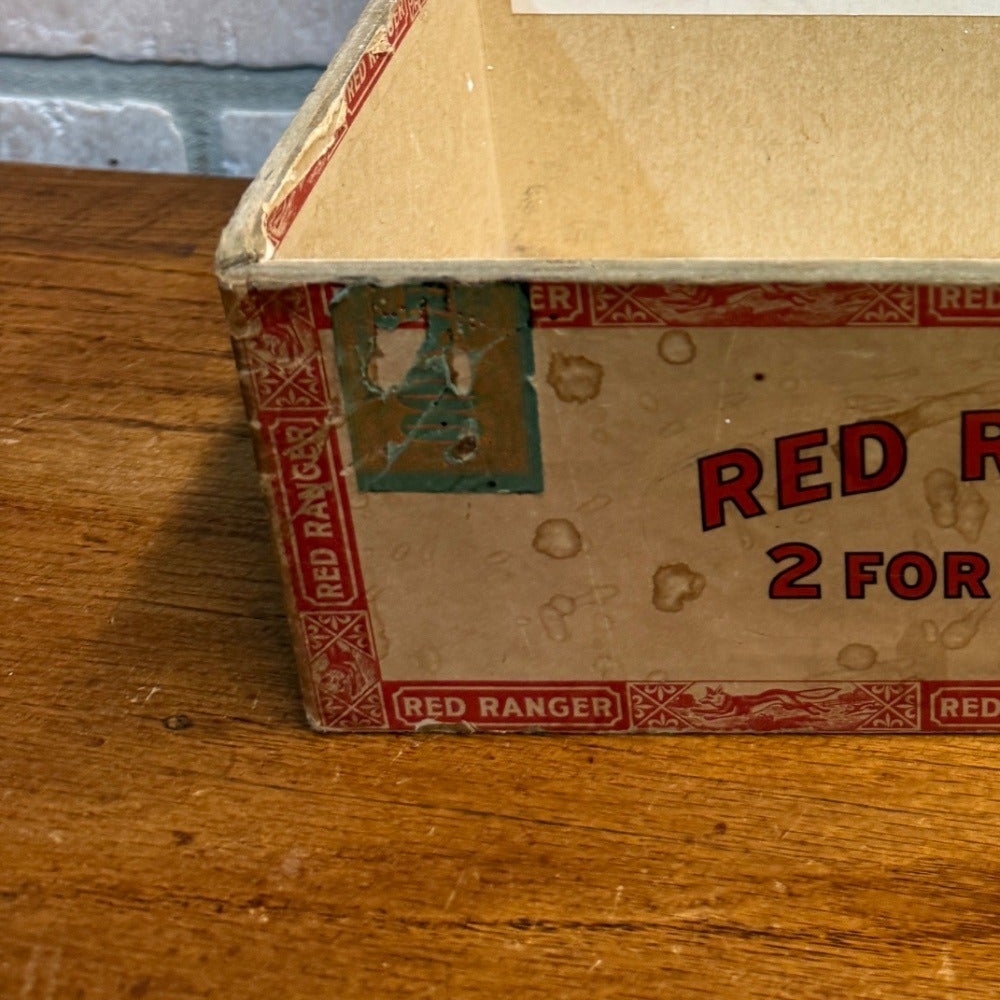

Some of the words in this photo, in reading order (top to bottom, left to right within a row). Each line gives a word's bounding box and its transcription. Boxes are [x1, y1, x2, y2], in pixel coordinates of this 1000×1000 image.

[697, 419, 908, 532] RED
[309, 547, 345, 600] RED
[767, 541, 823, 600] 2
[843, 550, 992, 601] FOR
[403, 696, 467, 718] RED
[478, 696, 613, 718] RANGER
